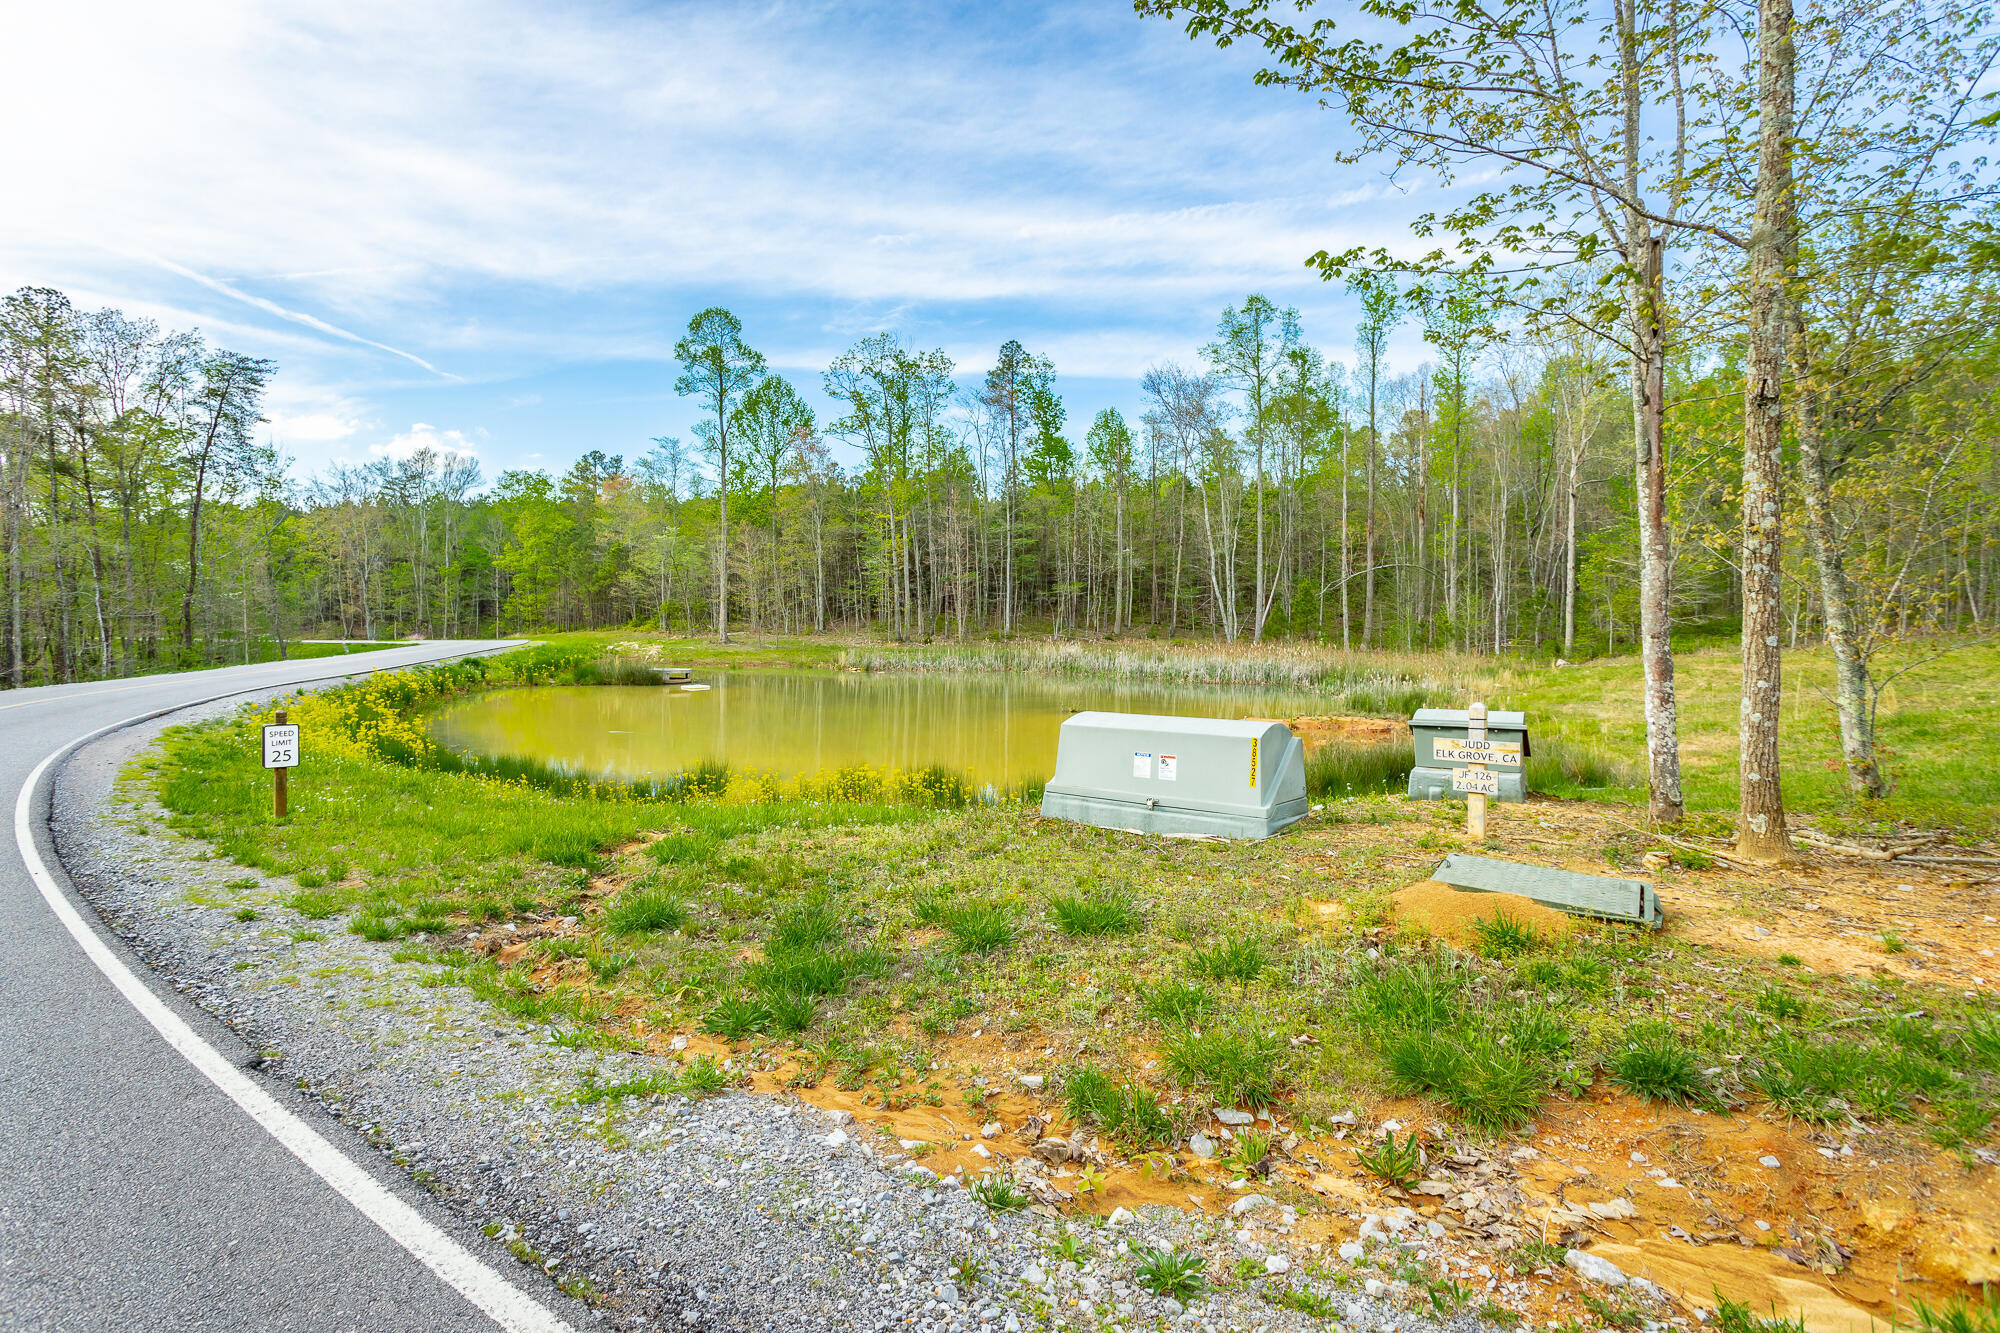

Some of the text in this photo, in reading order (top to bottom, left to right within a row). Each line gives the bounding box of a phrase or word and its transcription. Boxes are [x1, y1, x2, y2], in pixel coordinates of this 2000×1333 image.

[269, 730, 295, 738] SPEED
[271, 739, 292, 747] LIMIT
[1462, 740, 1491, 750] JUDD
[271, 749, 292, 763] 25
[1436, 749, 1517, 764] ELK GROVE, CA
[1475, 772, 1492, 781] 126
[1456, 780, 1495, 793] 2.04 AC
